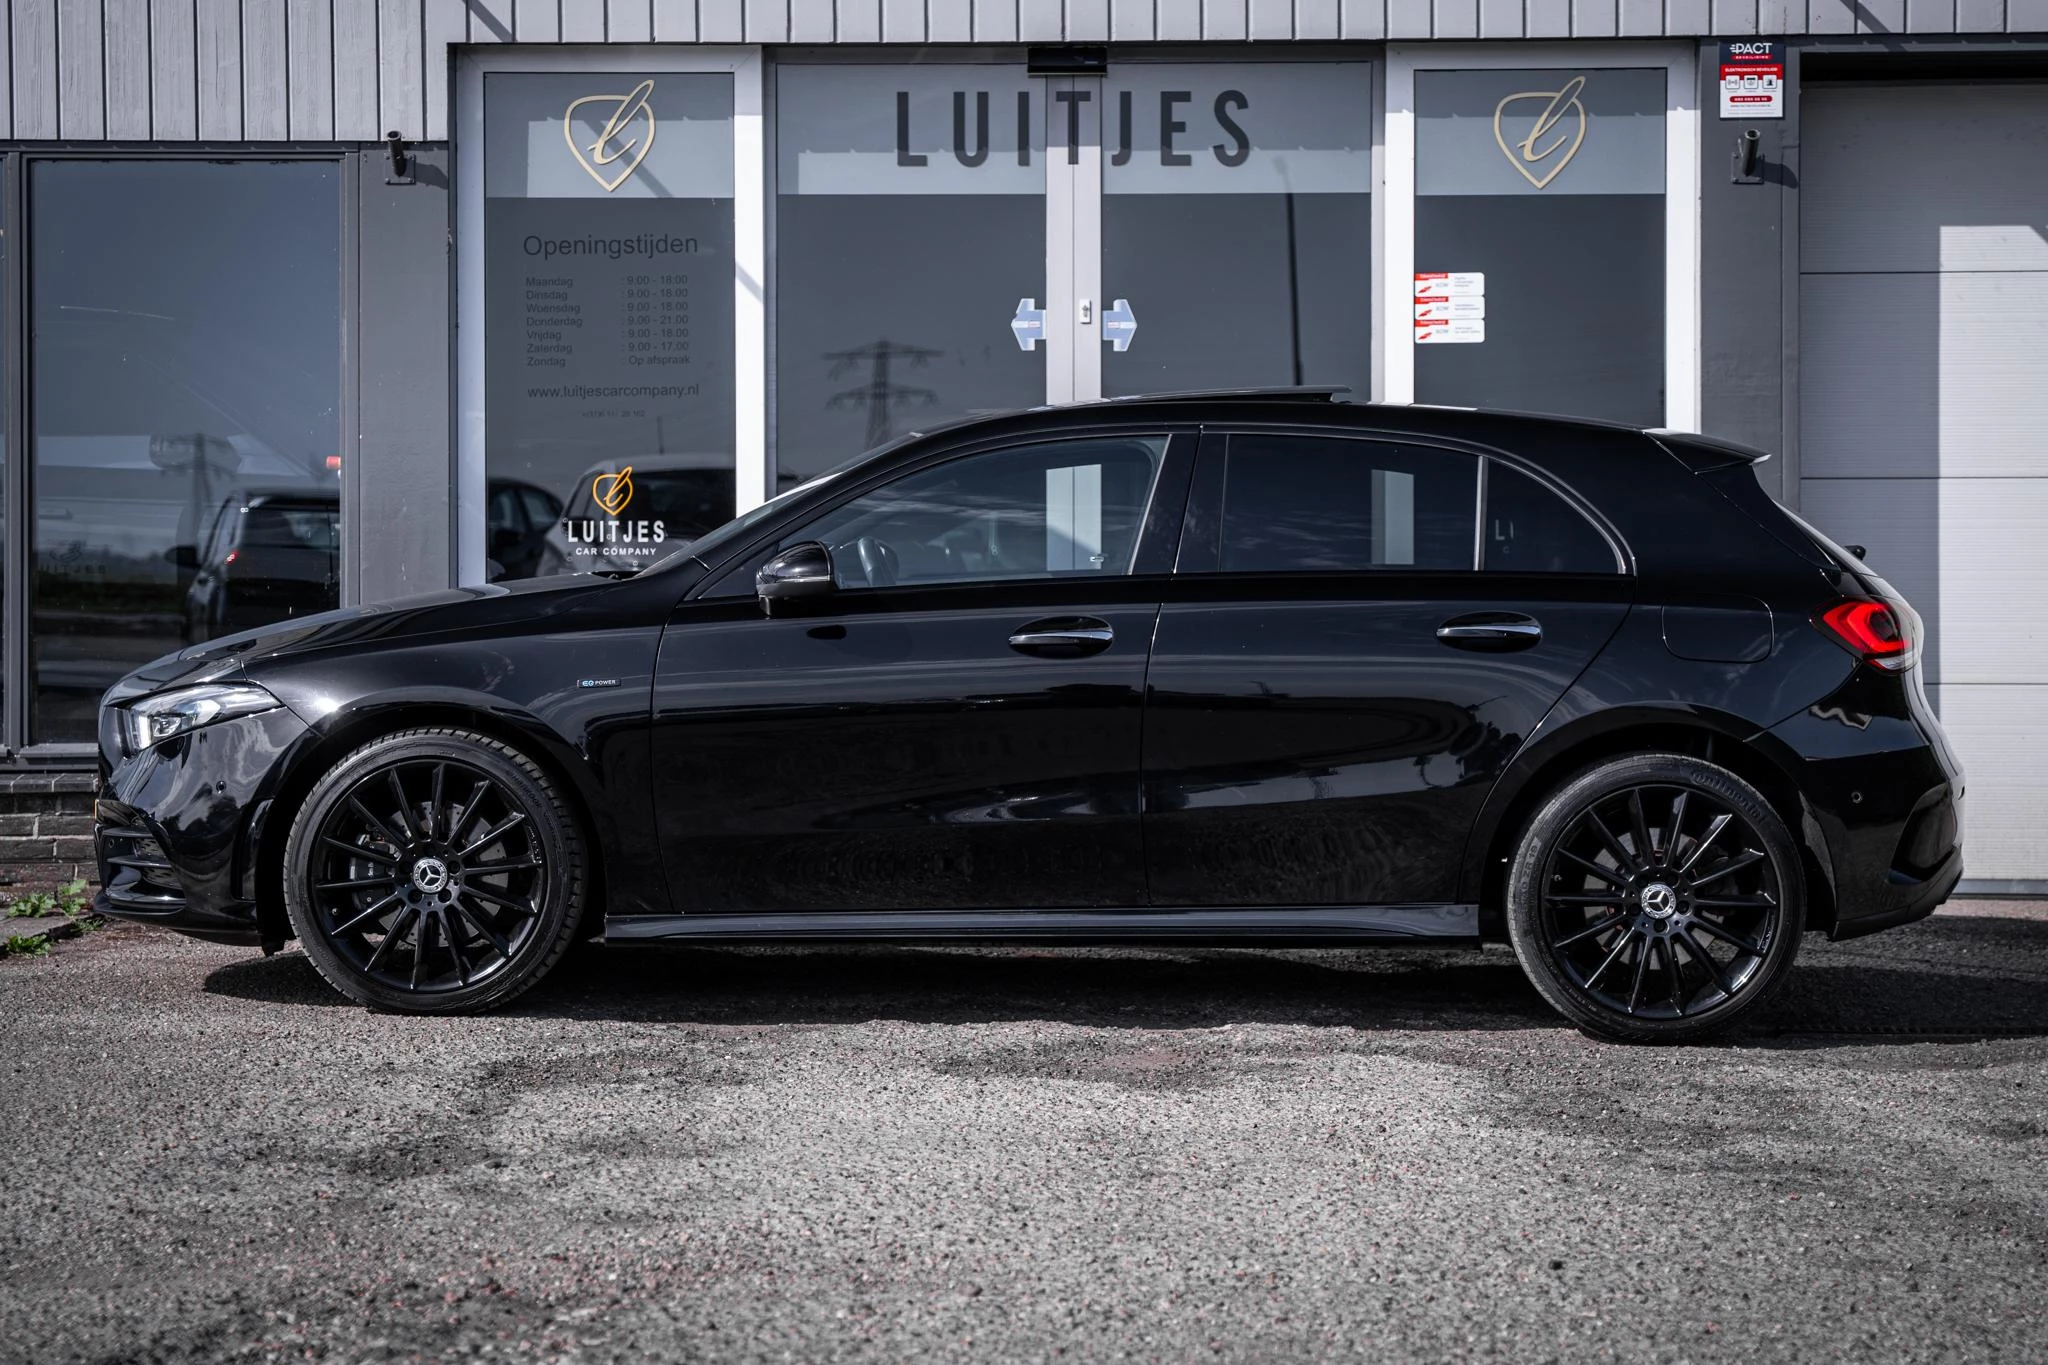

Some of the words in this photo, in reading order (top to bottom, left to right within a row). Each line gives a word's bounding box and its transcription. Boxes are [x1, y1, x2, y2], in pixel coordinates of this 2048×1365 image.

[1732, 43, 1773, 54] PACT
[896, 89, 1250, 168] LUITJES
[523, 234, 698, 260] Openingstijden
[525, 277, 574, 288] Maandag
[526, 290, 568, 301] Dinsdag
[526, 303, 581, 314] Woensdag
[526, 316, 583, 328] Donderdag
[527, 330, 562, 341] Vrijdag
[527, 343, 573, 354] Zaterdag
[527, 356, 566, 368] Zondag
[628, 355, 644, 366] Op
[646, 354, 691, 366] afspraak
[527, 384, 699, 399] www.luitjescarcompany.nl
[568, 520, 665, 543] LUITJES
[575, 547, 598, 555] CAR
[603, 547, 657, 555] COMPANY
